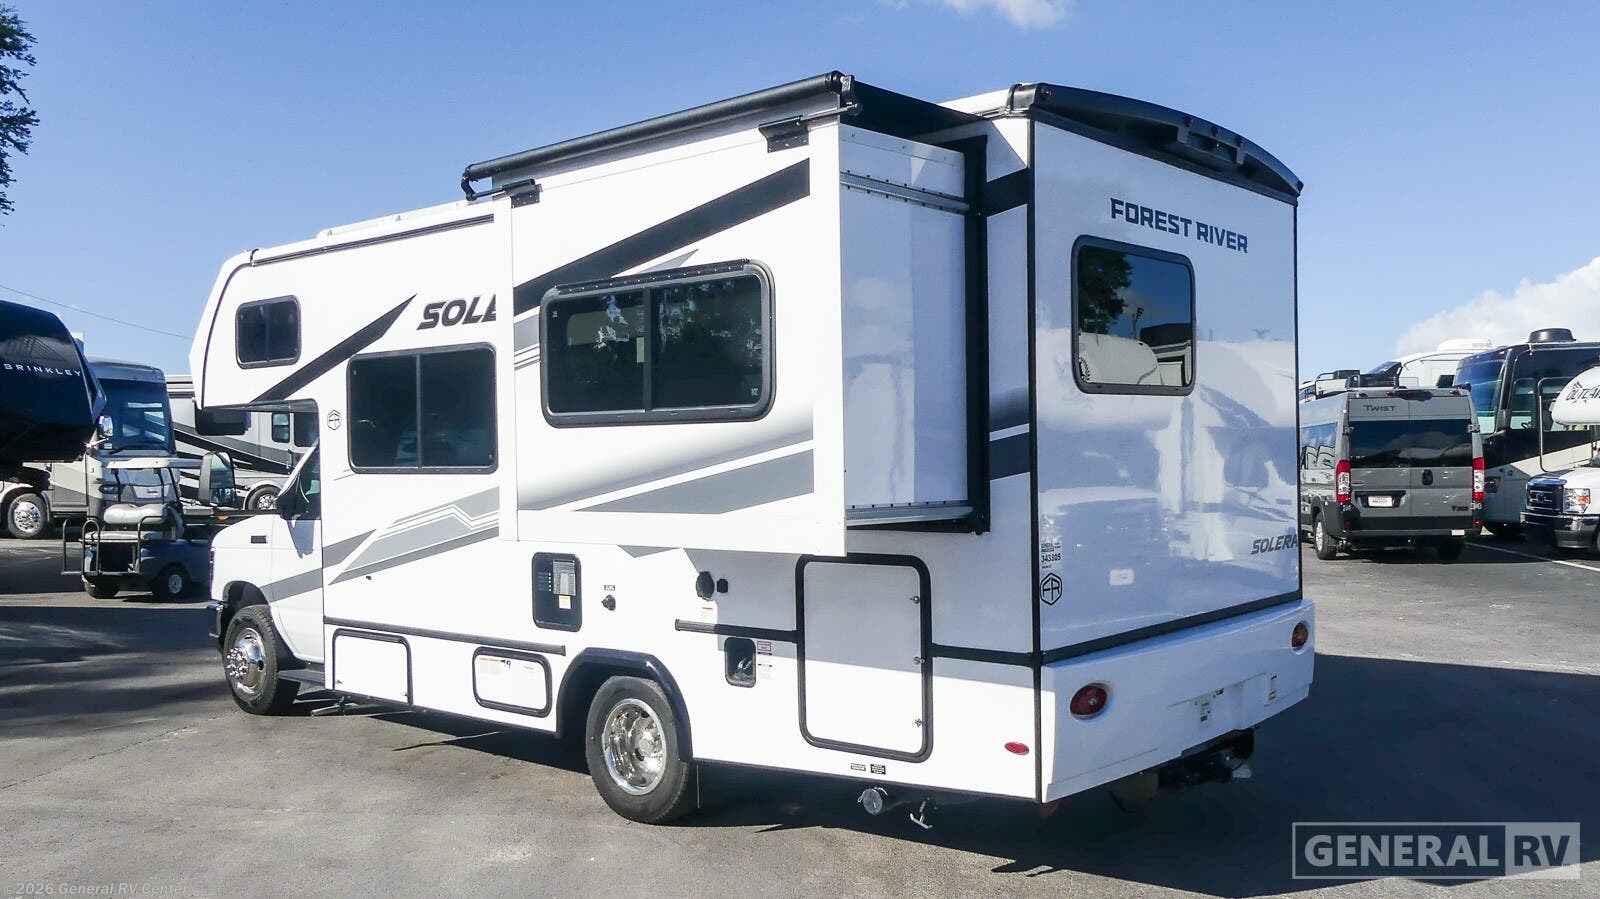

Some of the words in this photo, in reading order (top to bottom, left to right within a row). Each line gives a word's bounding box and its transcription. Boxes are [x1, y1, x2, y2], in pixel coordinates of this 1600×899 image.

[1110, 197, 1192, 237] FOREST
[1196, 221, 1248, 253] RIVER
[4, 363, 81, 377] BRINKLEY
[1250, 533, 1298, 555] SOLERA
